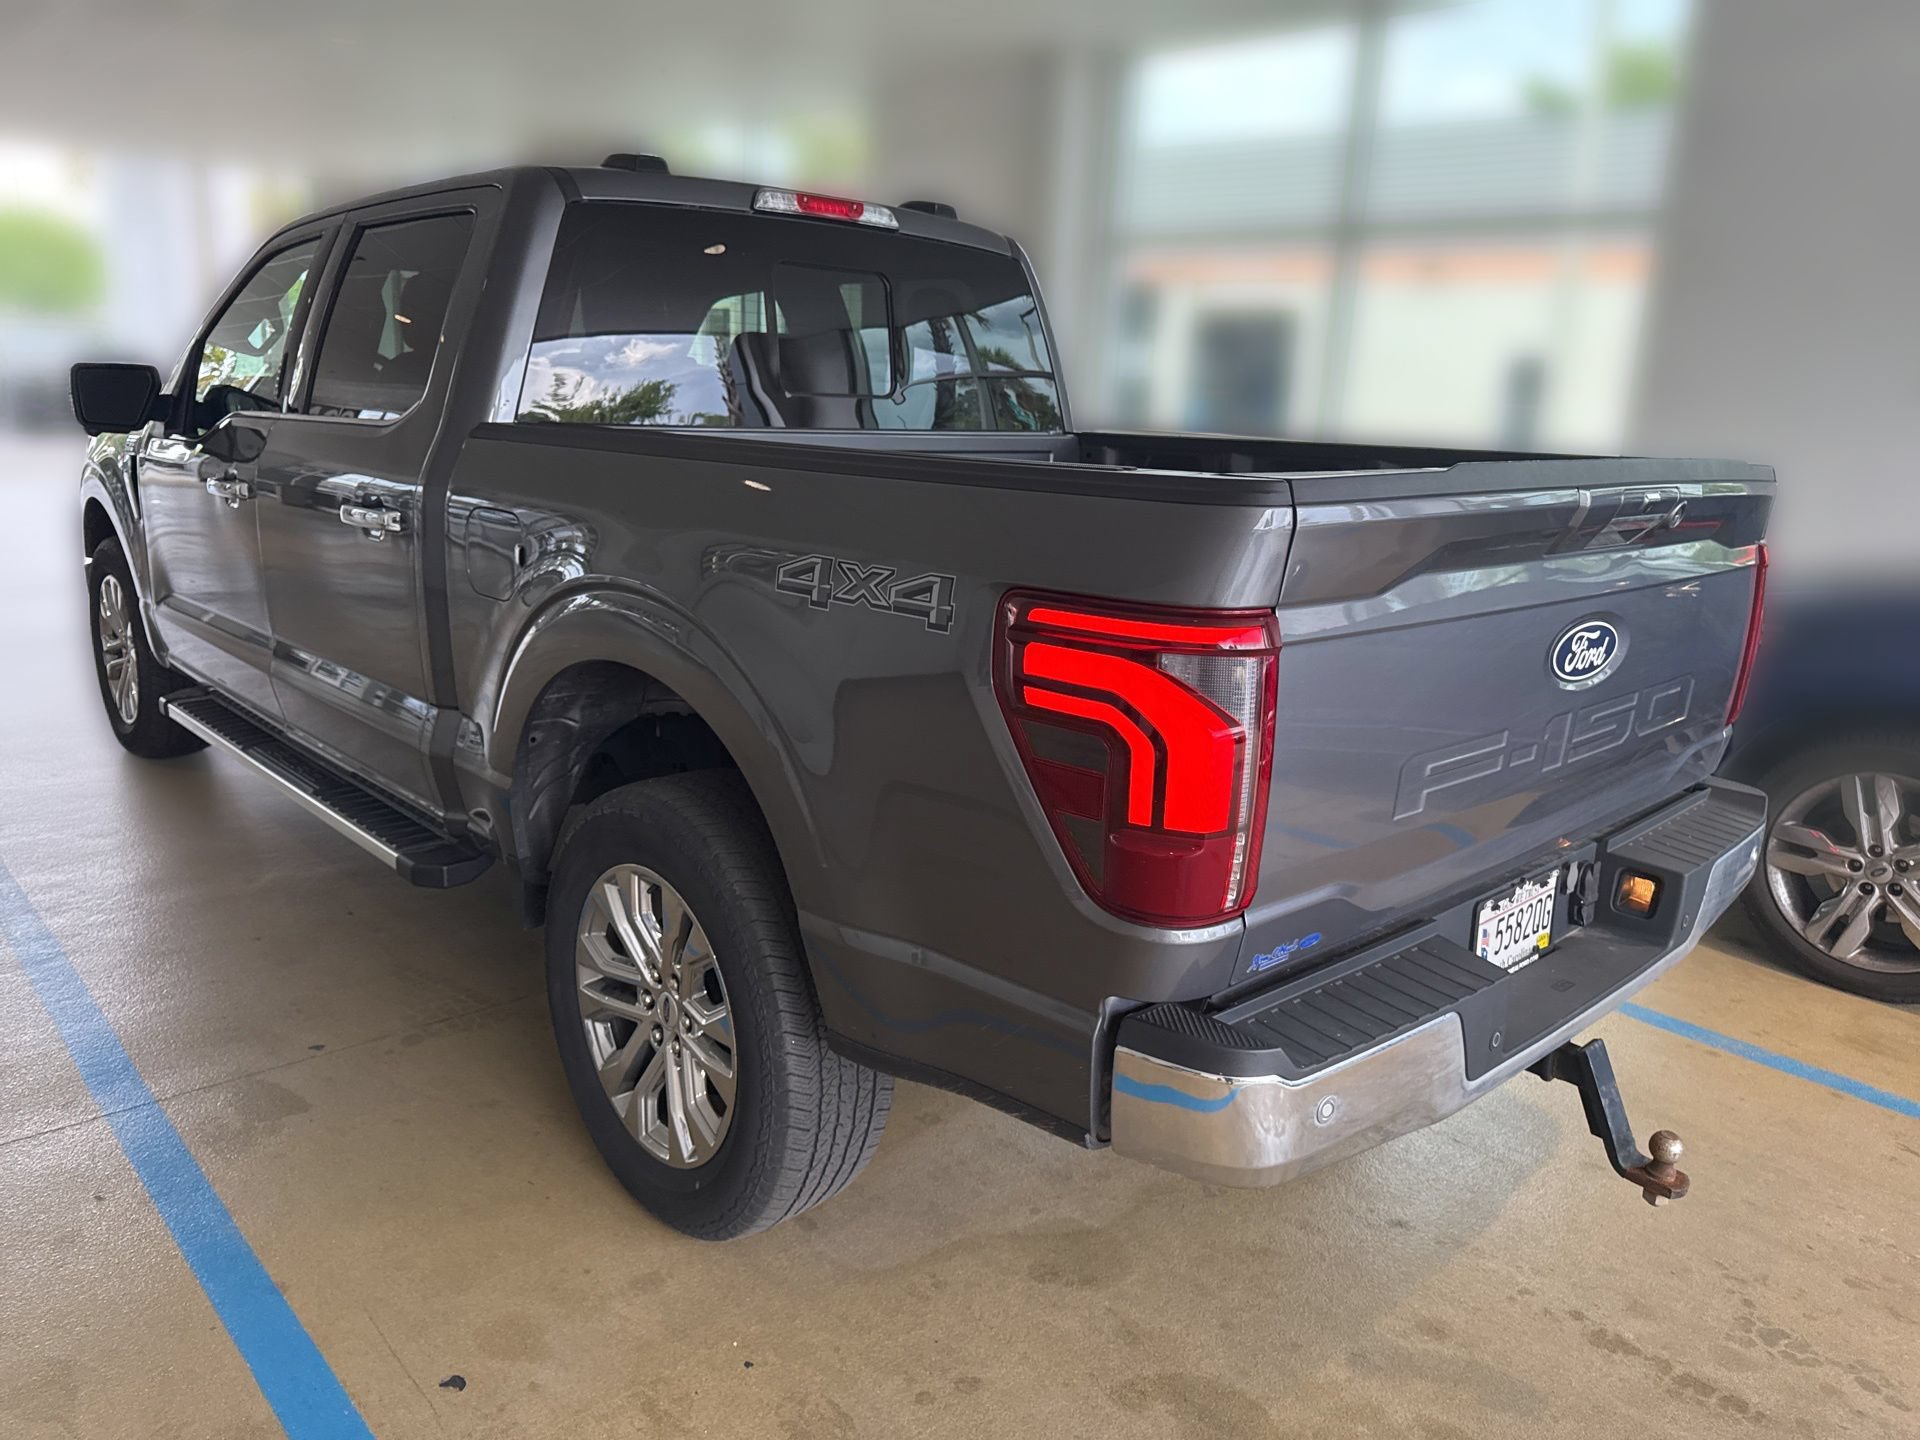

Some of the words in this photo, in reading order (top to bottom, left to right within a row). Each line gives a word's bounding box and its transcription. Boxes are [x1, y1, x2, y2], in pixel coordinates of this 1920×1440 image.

[1564, 630, 1610, 673] Ford
[1392, 674, 1695, 821] F-150
[1494, 893, 1553, 956] 5582QG
